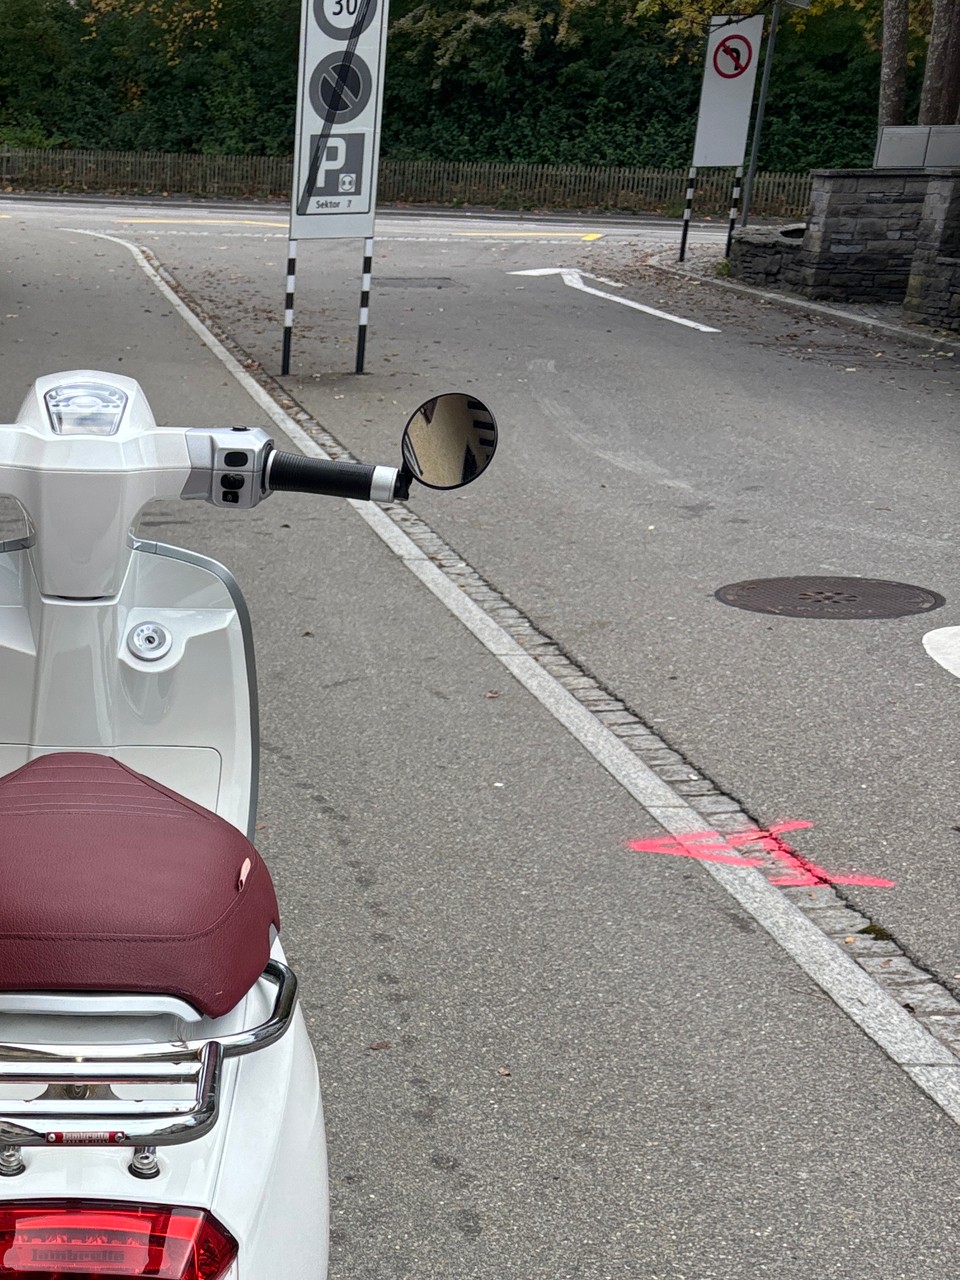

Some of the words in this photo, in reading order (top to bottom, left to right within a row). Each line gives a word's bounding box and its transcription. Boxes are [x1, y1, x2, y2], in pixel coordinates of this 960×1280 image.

[316, 137, 346, 188] P
[316, 200, 341, 209] Sektor
[346, 200, 352, 208] 7
